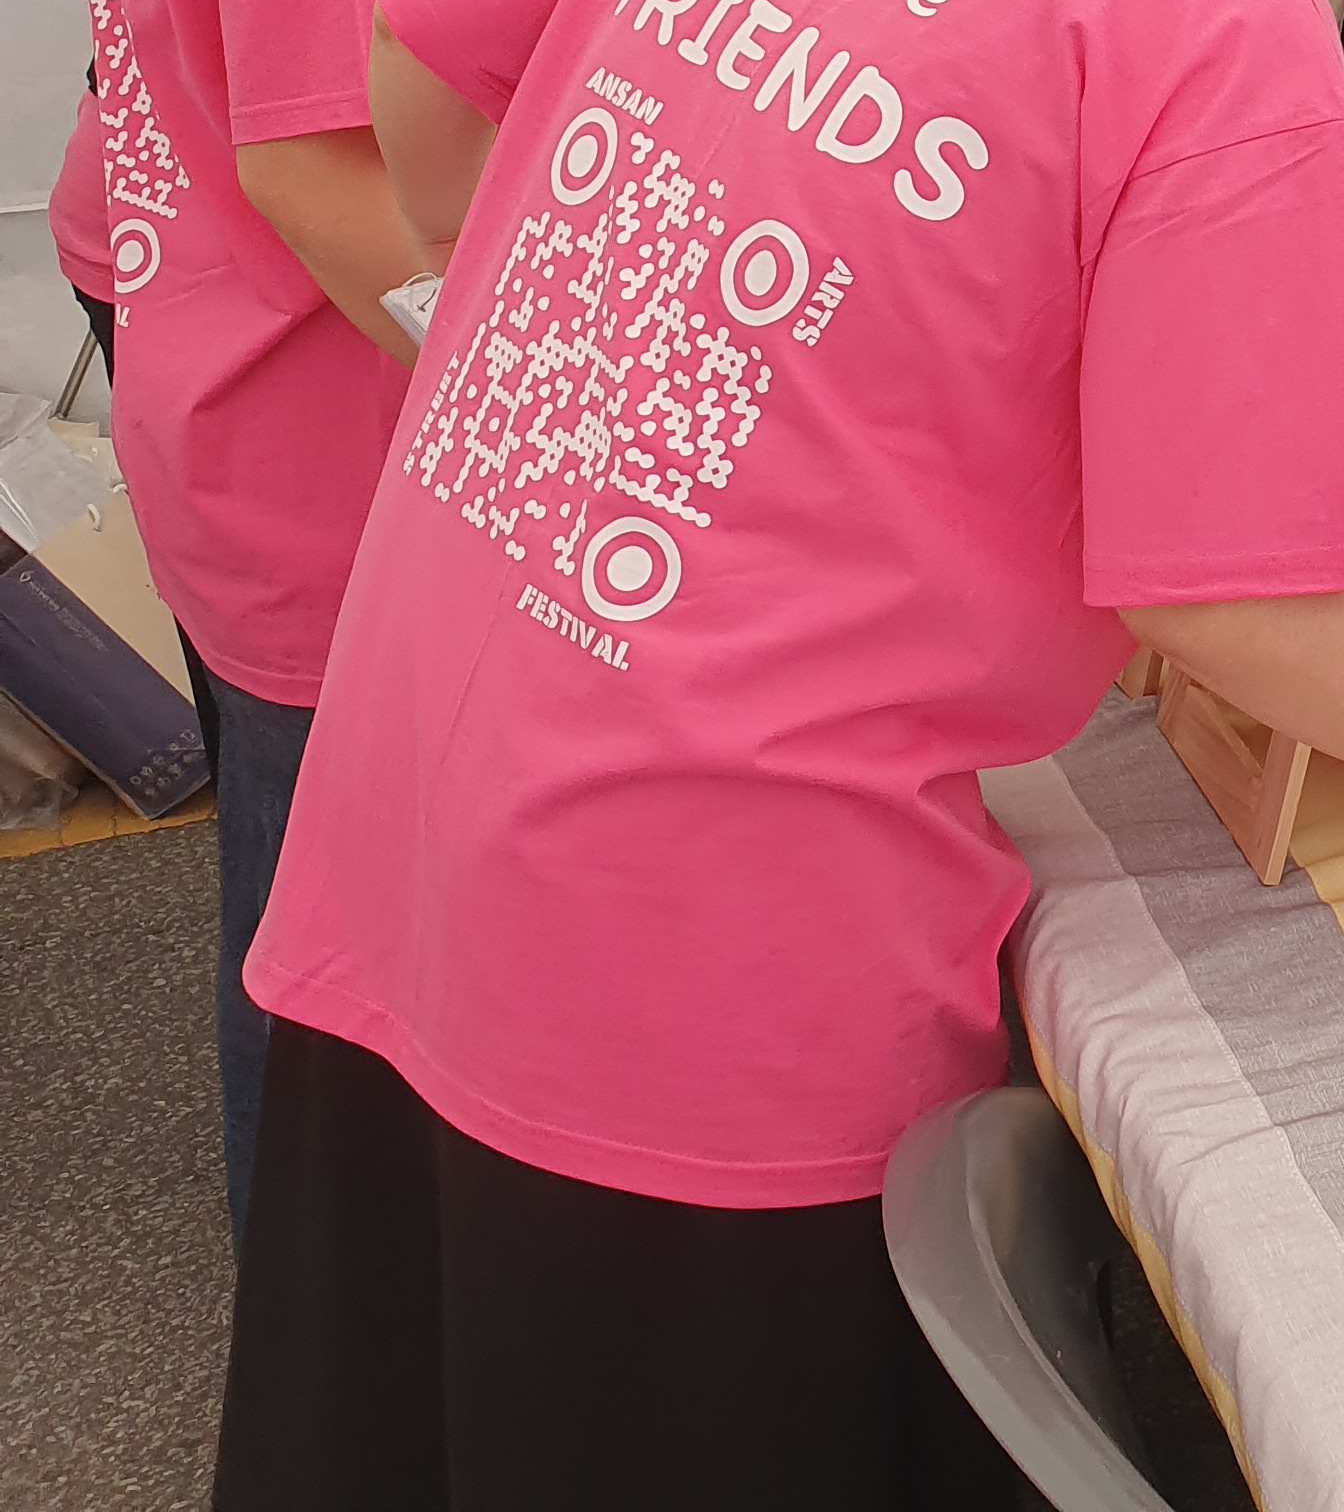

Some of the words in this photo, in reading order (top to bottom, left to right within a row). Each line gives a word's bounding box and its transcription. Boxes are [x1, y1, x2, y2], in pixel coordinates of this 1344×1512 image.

[585, 65, 664, 126] ANSAN
[790, 256, 857, 349] ARTS
[402, 349, 462, 477] STREET
[515, 582, 631, 672] FESTIVAL
